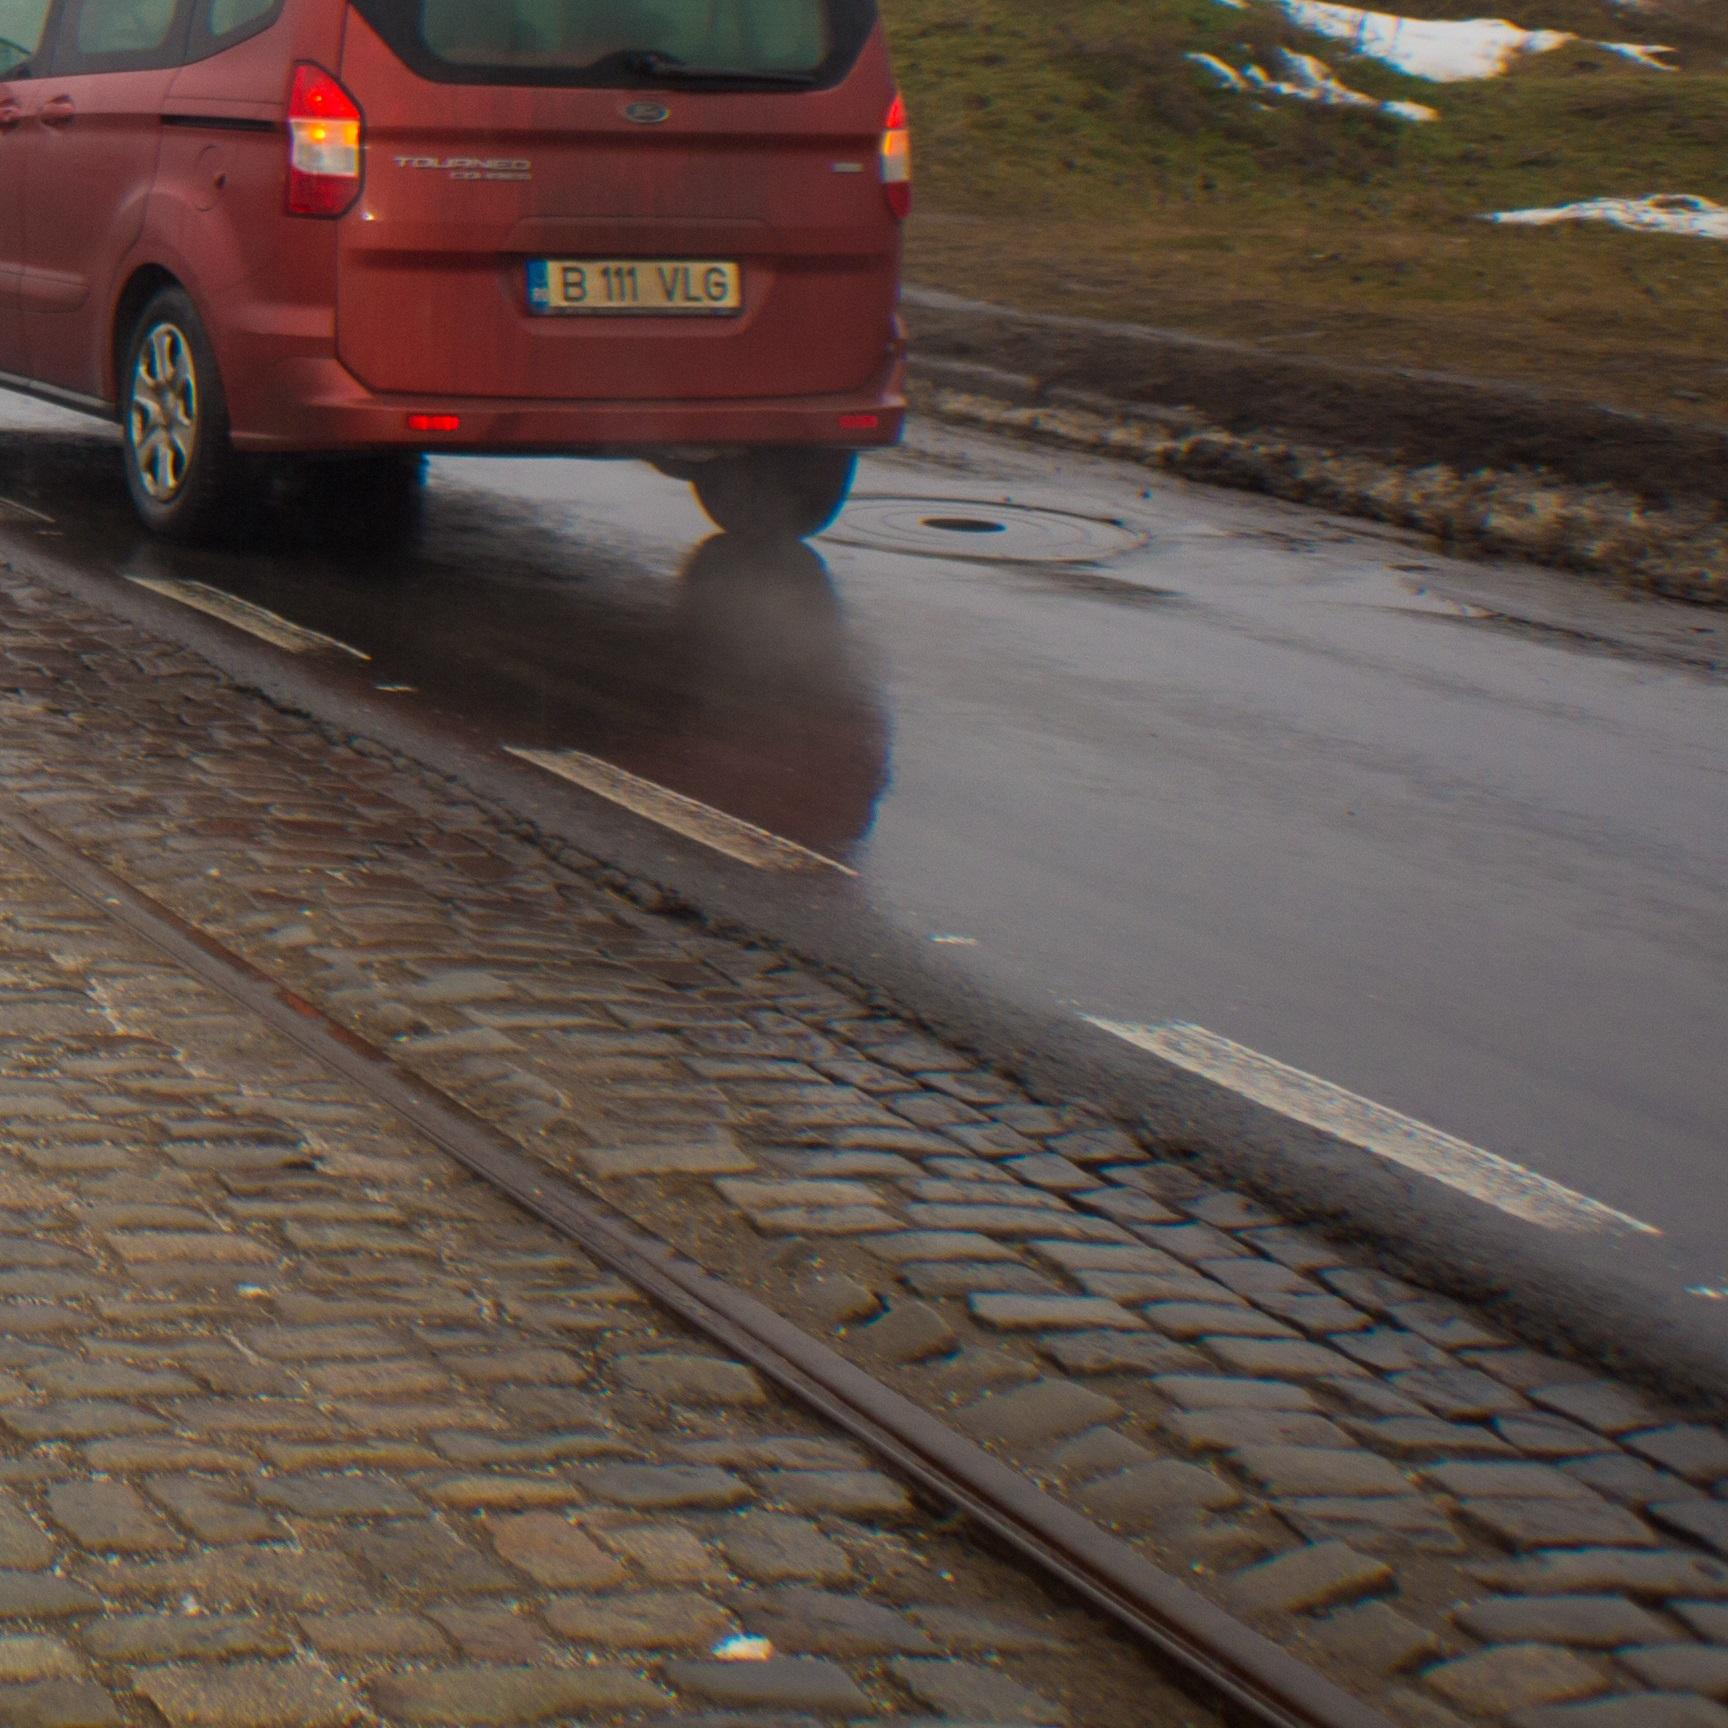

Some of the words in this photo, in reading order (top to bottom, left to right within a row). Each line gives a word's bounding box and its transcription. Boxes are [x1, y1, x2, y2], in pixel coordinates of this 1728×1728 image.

[394, 156, 531, 170] TOURNEO
[561, 265, 587, 302] B
[601, 265, 639, 302] 111
[657, 265, 729, 302] VLG
